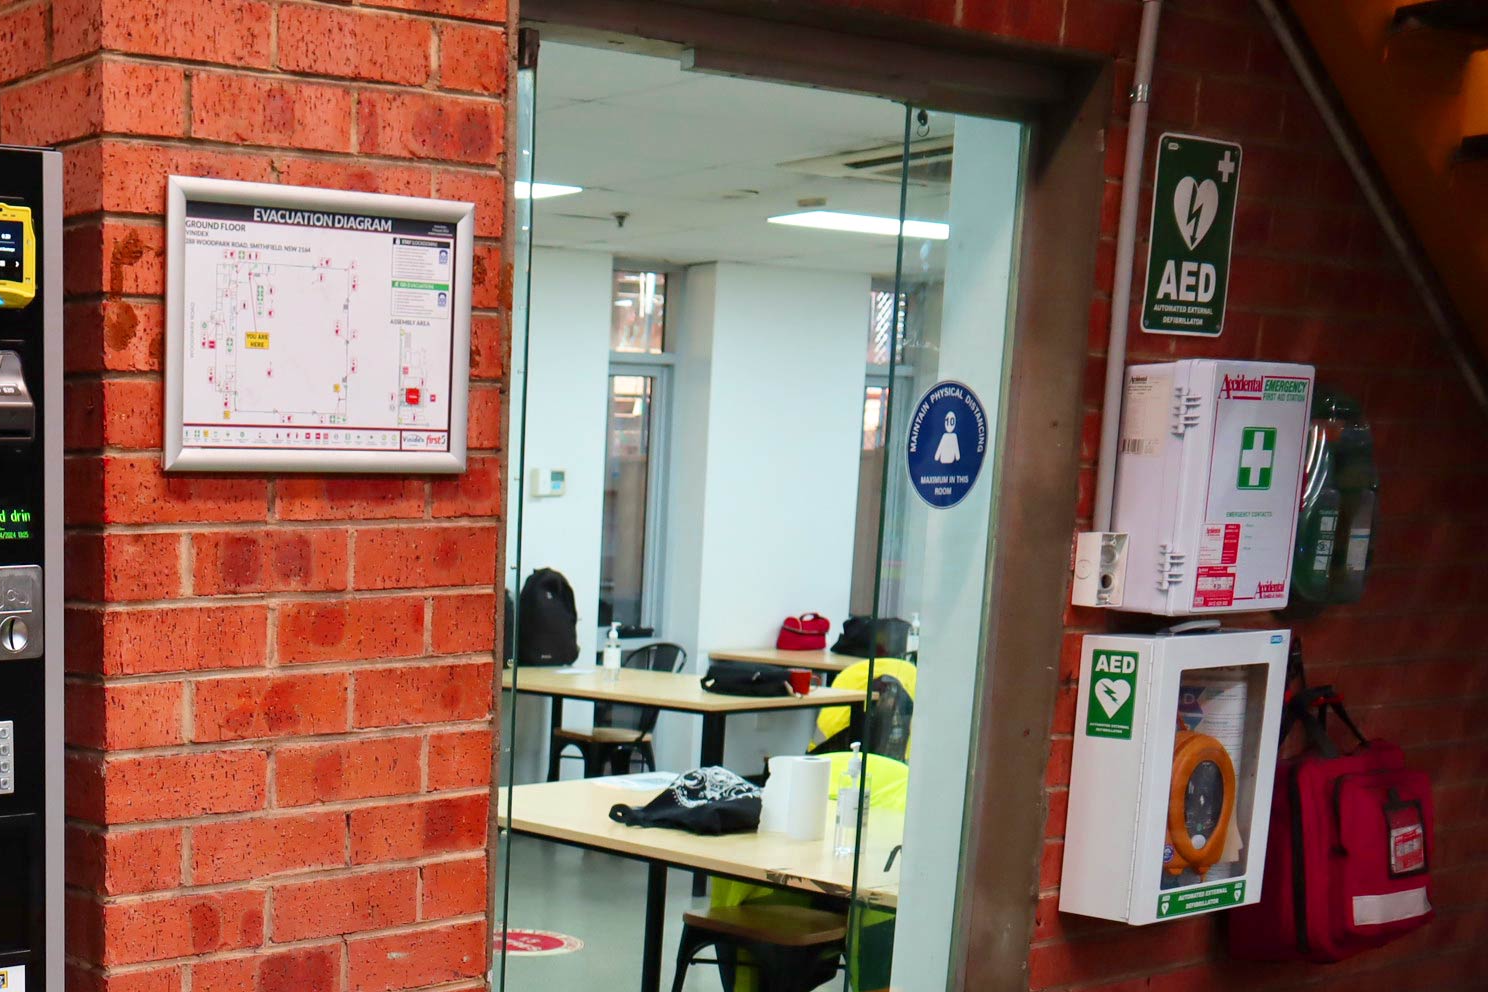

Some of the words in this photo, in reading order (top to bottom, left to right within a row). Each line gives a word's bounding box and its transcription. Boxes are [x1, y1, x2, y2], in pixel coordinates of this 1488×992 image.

[185, 220, 219, 230] GROUND
[221, 222, 246, 232] FLOOR
[253, 208, 332, 228] EVACUATION
[334, 214, 392, 232] DIAGRAM
[196, 239, 230, 247] WOODPARK
[1156, 259, 1217, 304] AED
[1153, 303, 1187, 314] AUTOMATED
[1187, 305, 1213, 315] EXTERNAL
[1162, 317, 1203, 326] DEFIBRILLATOR
[1217, 373, 1264, 400] Accidental
[1264, 379, 1308, 393] EMERGENCY
[910, 402, 930, 453] MAINTAIN
[930, 387, 964, 404] PHYSICAL
[965, 395, 985, 453] DISTANCING
[920, 475, 949, 485] MAXIMUM
[949, 476, 955, 484] IN
[956, 475, 969, 483] THIS
[934, 487, 952, 496] ROOM
[1095, 654, 1136, 674] AED
